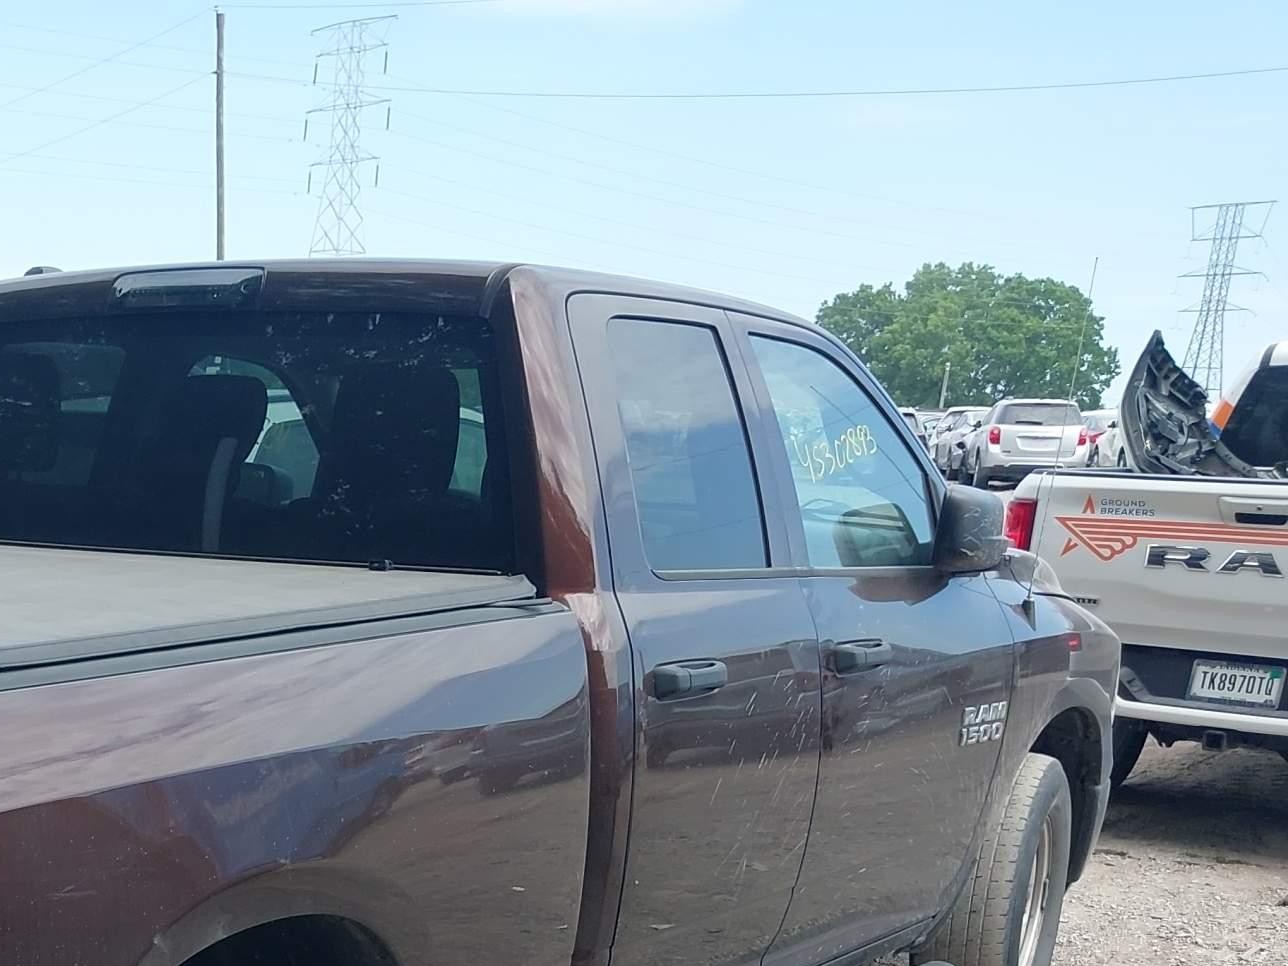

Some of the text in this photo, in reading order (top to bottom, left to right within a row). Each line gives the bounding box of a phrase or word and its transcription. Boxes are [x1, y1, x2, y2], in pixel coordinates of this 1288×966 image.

[1099, 507, 1155, 517] BREAKERS
[1100, 498, 1146, 508] GROUND
[1144, 543, 1285, 579] RA
[963, 700, 1008, 725] RAM
[958, 721, 1003, 746] 1500
